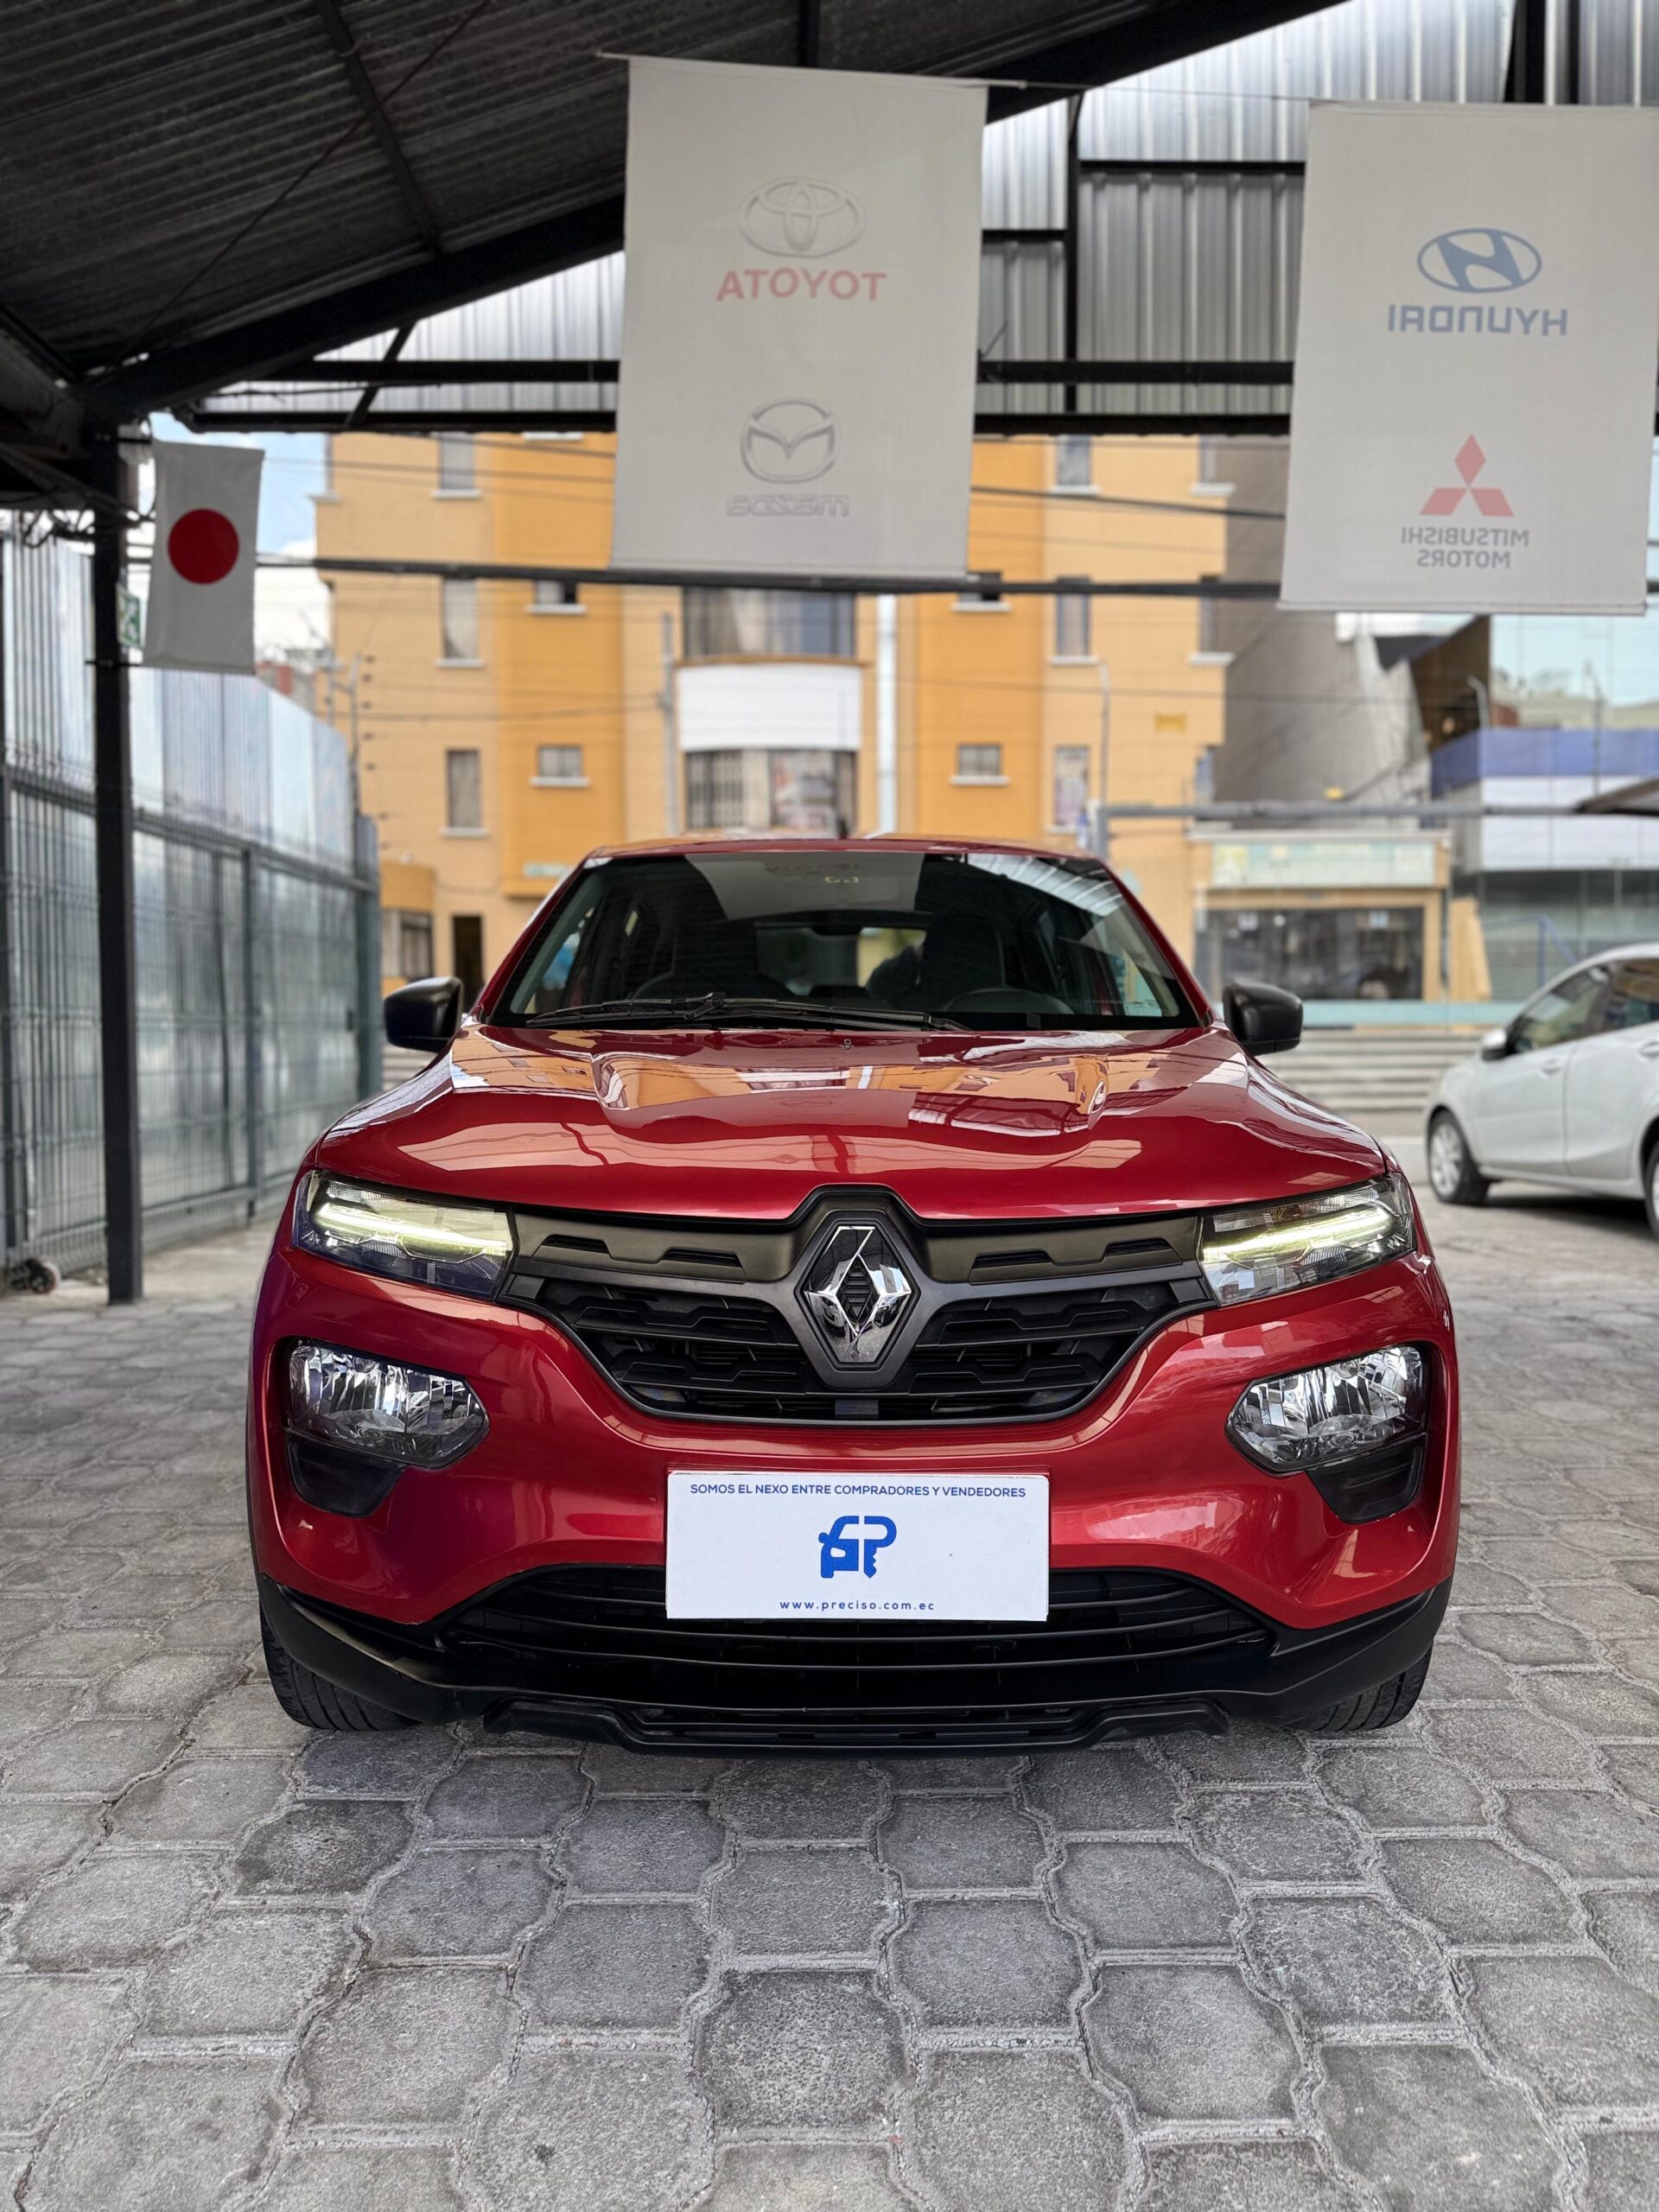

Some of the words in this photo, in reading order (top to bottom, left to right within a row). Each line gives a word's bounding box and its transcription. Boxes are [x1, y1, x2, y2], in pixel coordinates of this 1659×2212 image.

[690, 1484, 735, 1495] SOMOS
[738, 1484, 753, 1495] EL
[754, 1484, 789, 1495] NEXO
[791, 1484, 831, 1495] ENTRE
[834, 1485, 931, 1497] COMPRADORES
[932, 1486, 941, 1497] Y
[942, 1486, 1027, 1497] VENDEDORES
[779, 1599, 935, 1612] www.preciso.com.ec
